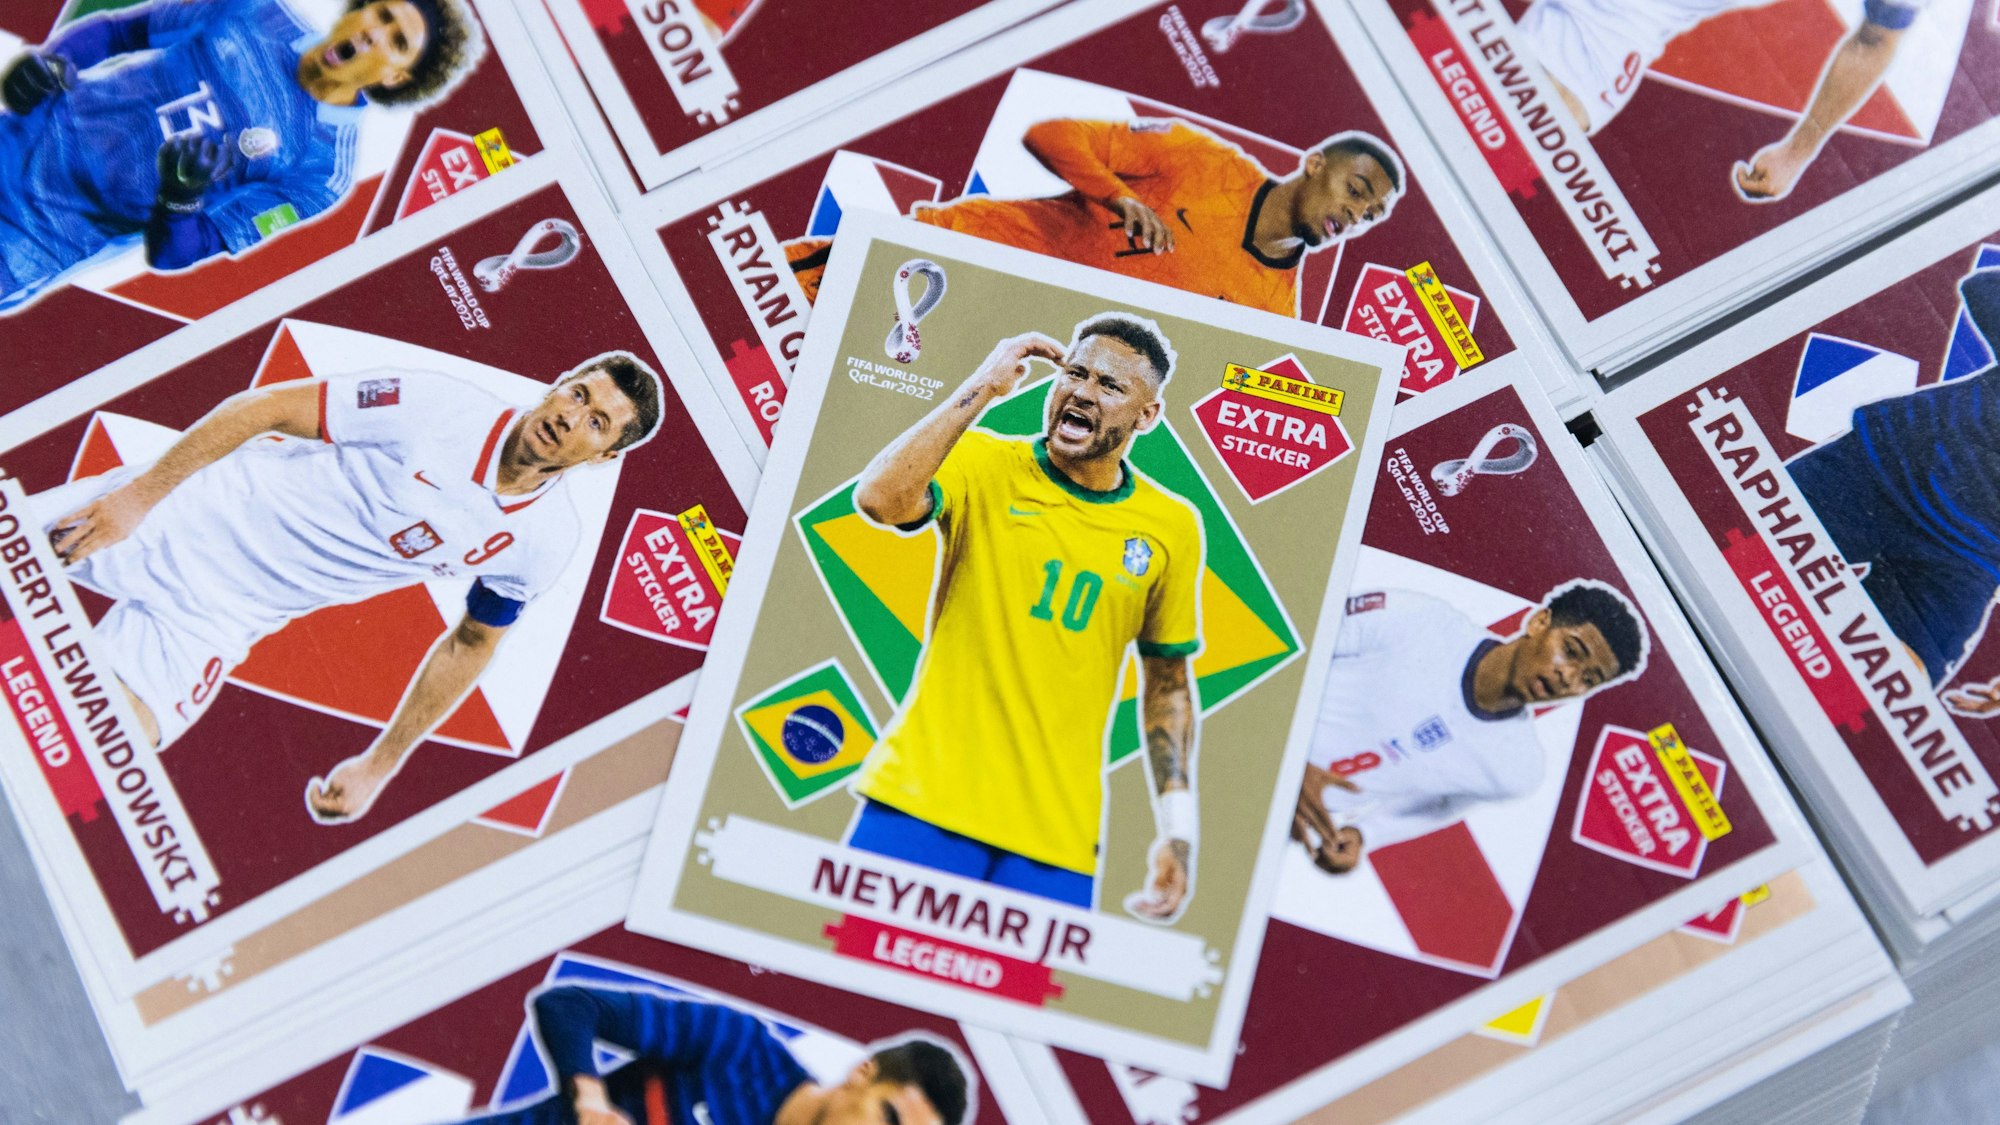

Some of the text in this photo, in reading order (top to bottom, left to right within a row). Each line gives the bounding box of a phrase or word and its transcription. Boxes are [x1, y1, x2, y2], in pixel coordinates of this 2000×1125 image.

[1181, 27, 1207, 65] WORLD
[1202, 64, 1220, 86] CUP
[1432, 48, 1506, 149] LEGEND
[1470, 21, 1638, 262] LEWANDOWSKI
[439, 246, 491, 329] FIFA WORLD CUP
[722, 224, 797, 328] RYAN
[1374, 280, 1444, 382] EXTRA
[1431, 290, 1479, 361] PANINI
[847, 356, 944, 390] FIFA WORLD CUP
[1257, 375, 1338, 405] PANINI
[1217, 400, 1327, 450] EXTRA
[1221, 435, 1311, 470] STICKER
[1395, 447, 1450, 534] FIFA WORLD CUP
[464, 531, 515, 566] 9
[644, 525, 716, 633] EXTRA
[626, 552, 681, 634] STICKER
[1029, 559, 1103, 633] 10
[1704, 412, 1974, 798] RAPHAËL VARANE
[1751, 570, 1832, 679] LEGEND
[1, 655, 71, 768] LEGEND
[43, 623, 197, 893] LEWANDOWSKI
[1613, 744, 1691, 857] EXTRA
[1675, 756, 1724, 830] PANINI
[1596, 768, 1657, 857] STICKER
[812, 857, 1092, 965] NEYMAR JR
[872, 930, 1004, 989] LEGEND
